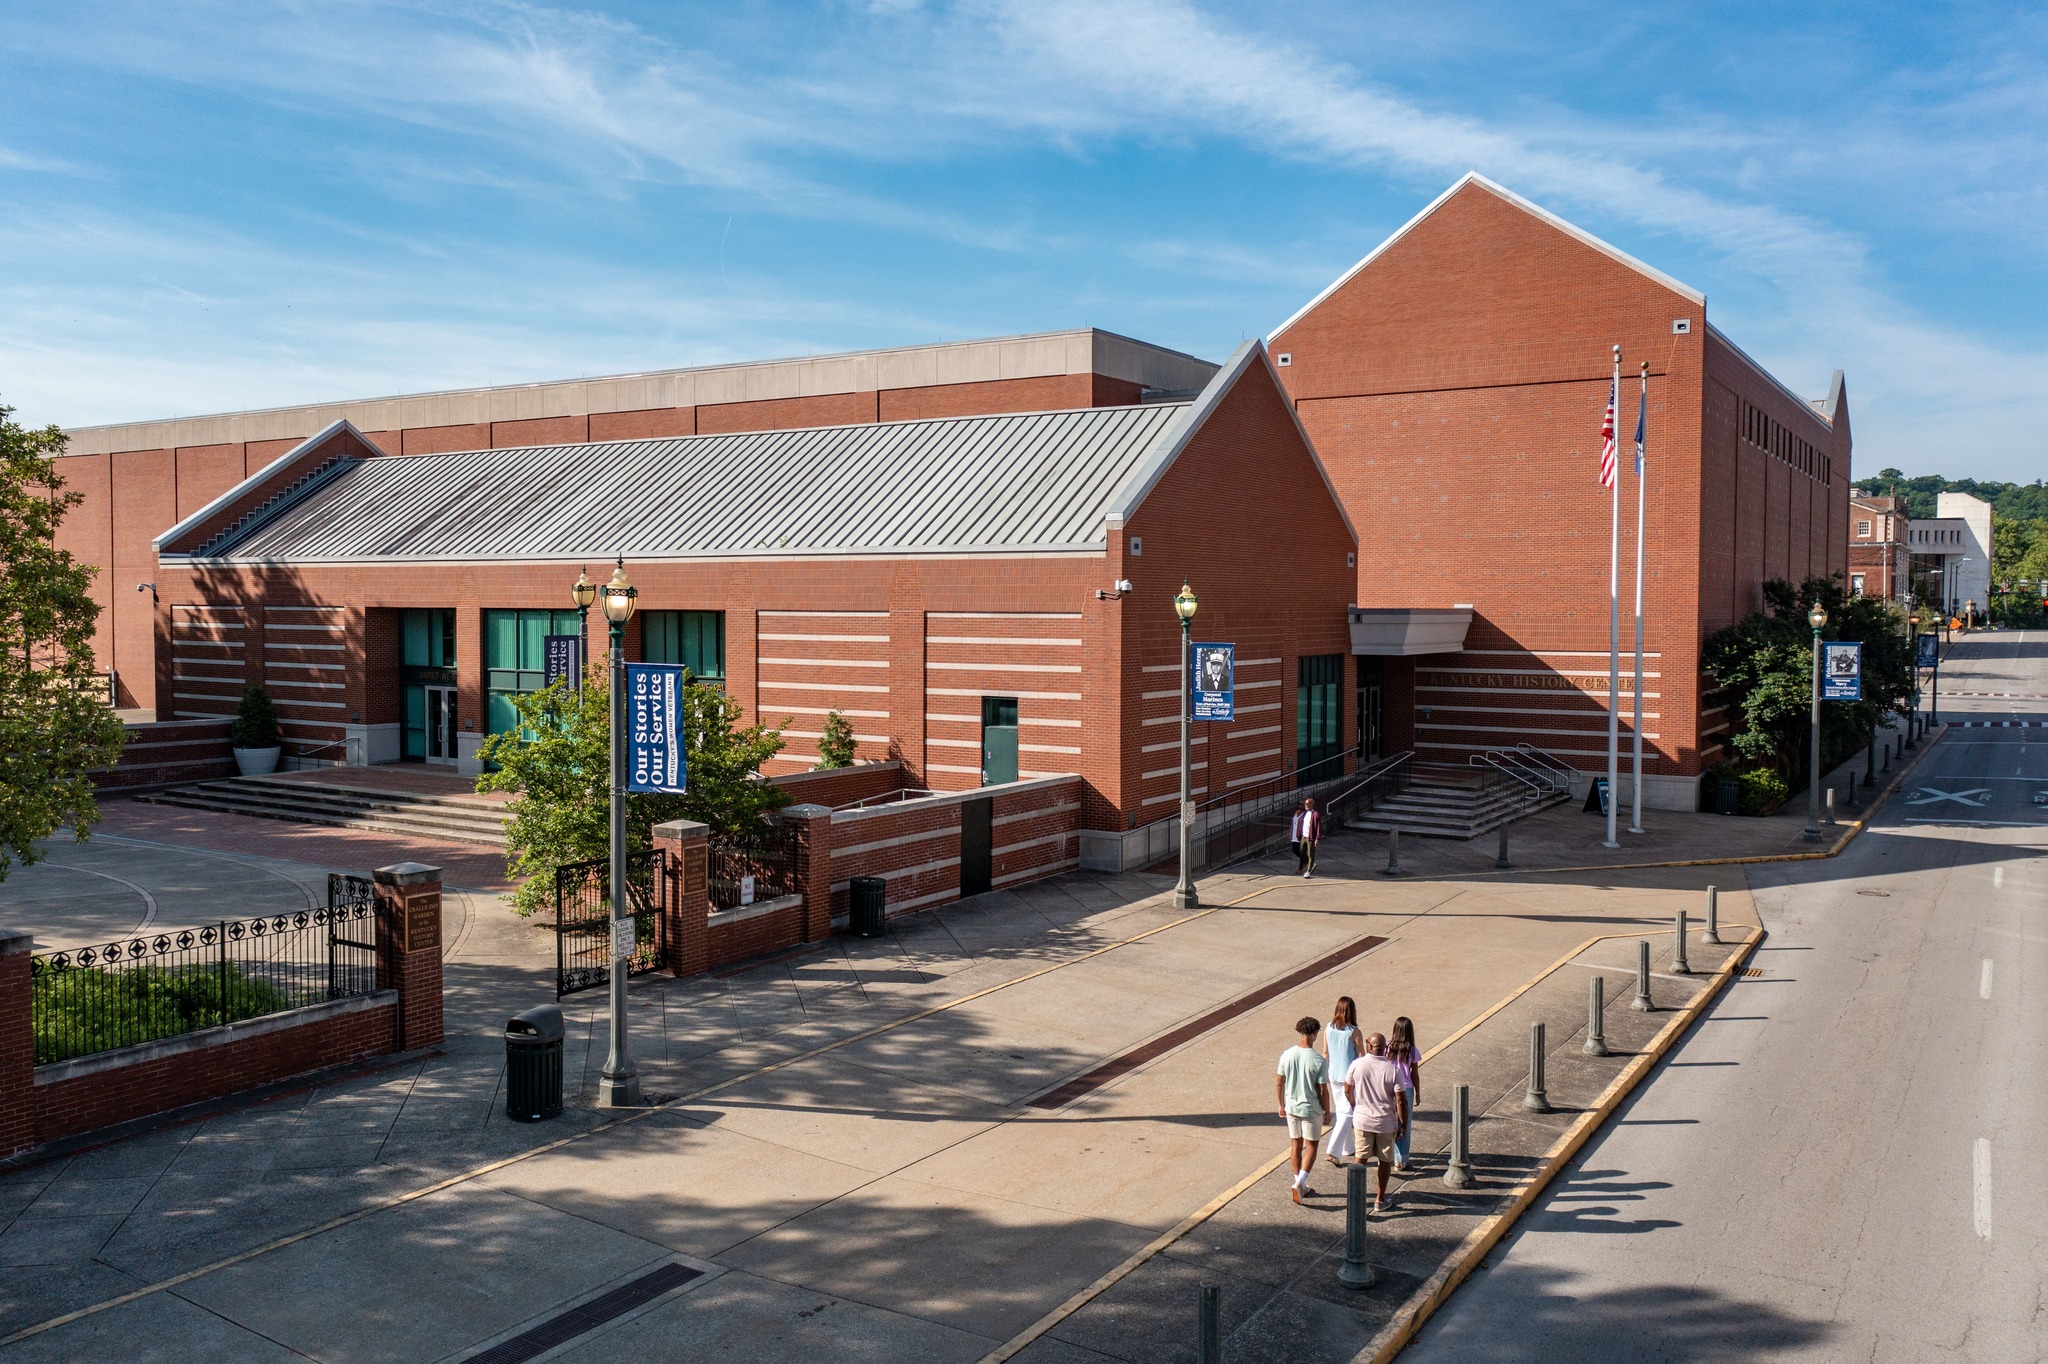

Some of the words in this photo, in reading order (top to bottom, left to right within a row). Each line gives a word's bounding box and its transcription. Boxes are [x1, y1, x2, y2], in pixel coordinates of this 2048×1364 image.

[549, 641, 558, 684] Stories
[558, 641, 567, 677] ervice
[419, 672, 439, 680] UNITED
[1431, 674, 1505, 687] KENTUCKY
[1513, 675, 1577, 689] HISTORY
[1583, 677, 1637, 690] CENTE
[634, 673, 648, 744] Stories
[649, 673, 663, 744] Service
[636, 747, 648, 784] Our
[651, 748, 663, 785] Our
[1979, 793, 1992, 801] R
[413, 911, 434, 920] GARDEN
[410, 925, 437, 935] KENTUCKY
[413, 932, 434, 941] HISTORY
[414, 939, 433, 948] CENTER
